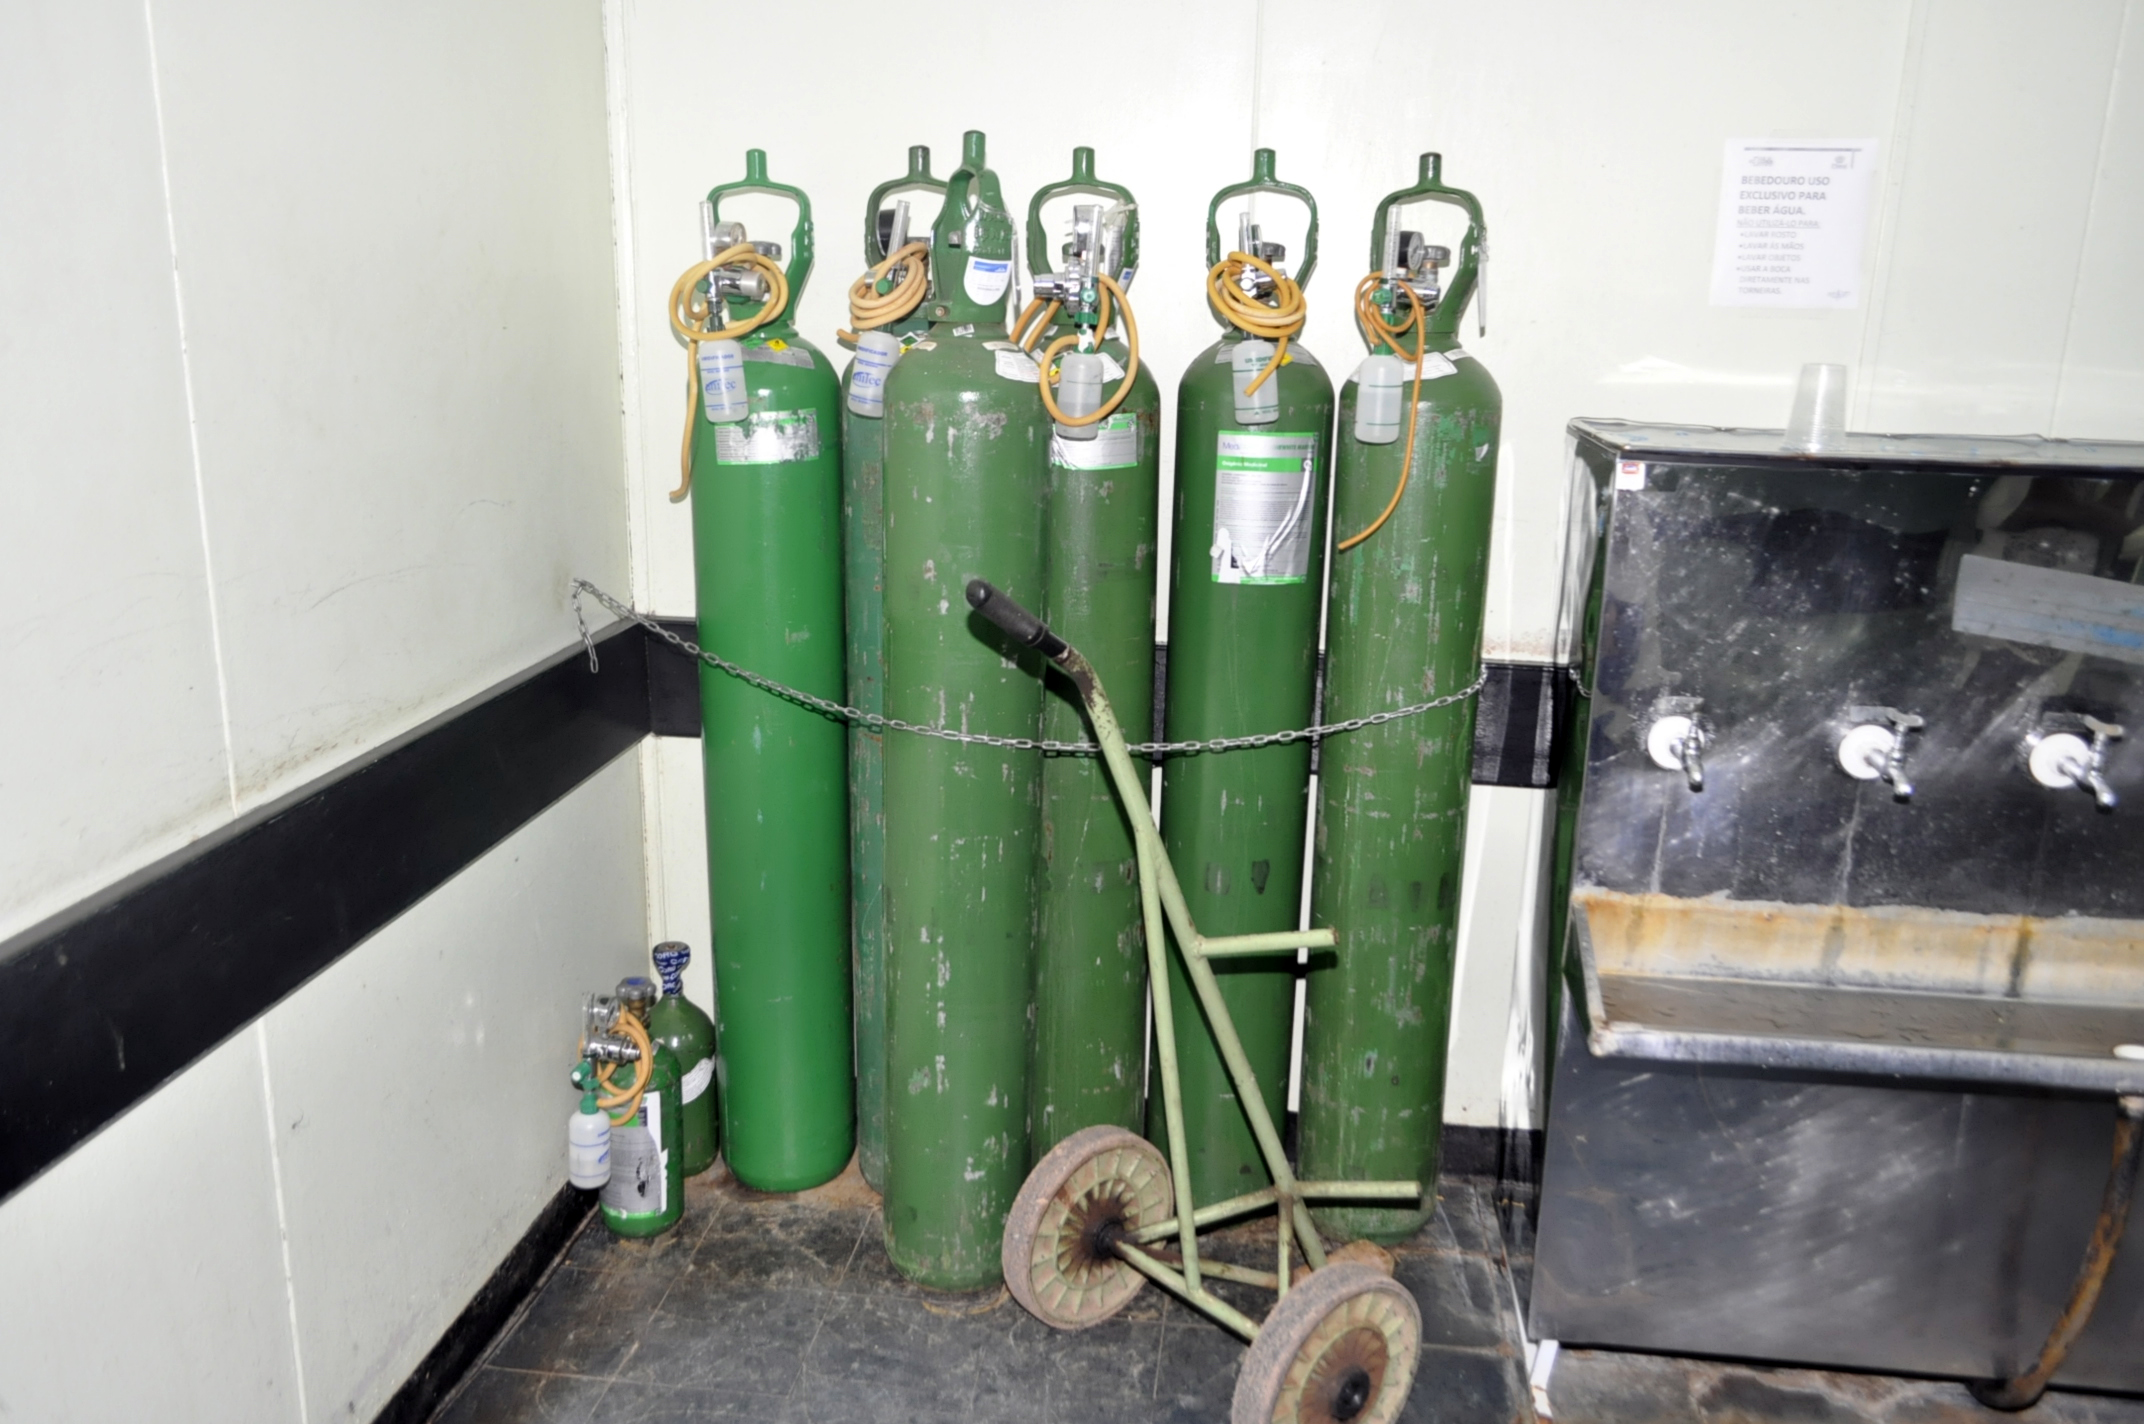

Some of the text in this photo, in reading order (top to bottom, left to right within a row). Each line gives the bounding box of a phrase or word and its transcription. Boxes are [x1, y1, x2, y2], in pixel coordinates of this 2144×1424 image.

[1741, 175, 1830, 186] BEBEDOURO USO
[1739, 191, 1827, 200] EXCLUSIVO PARA
[1738, 204, 1806, 215] BEBER ÁGUA.
[1737, 218, 1754, 227] NÃO
[1781, 242, 1804, 250] MÃOS
